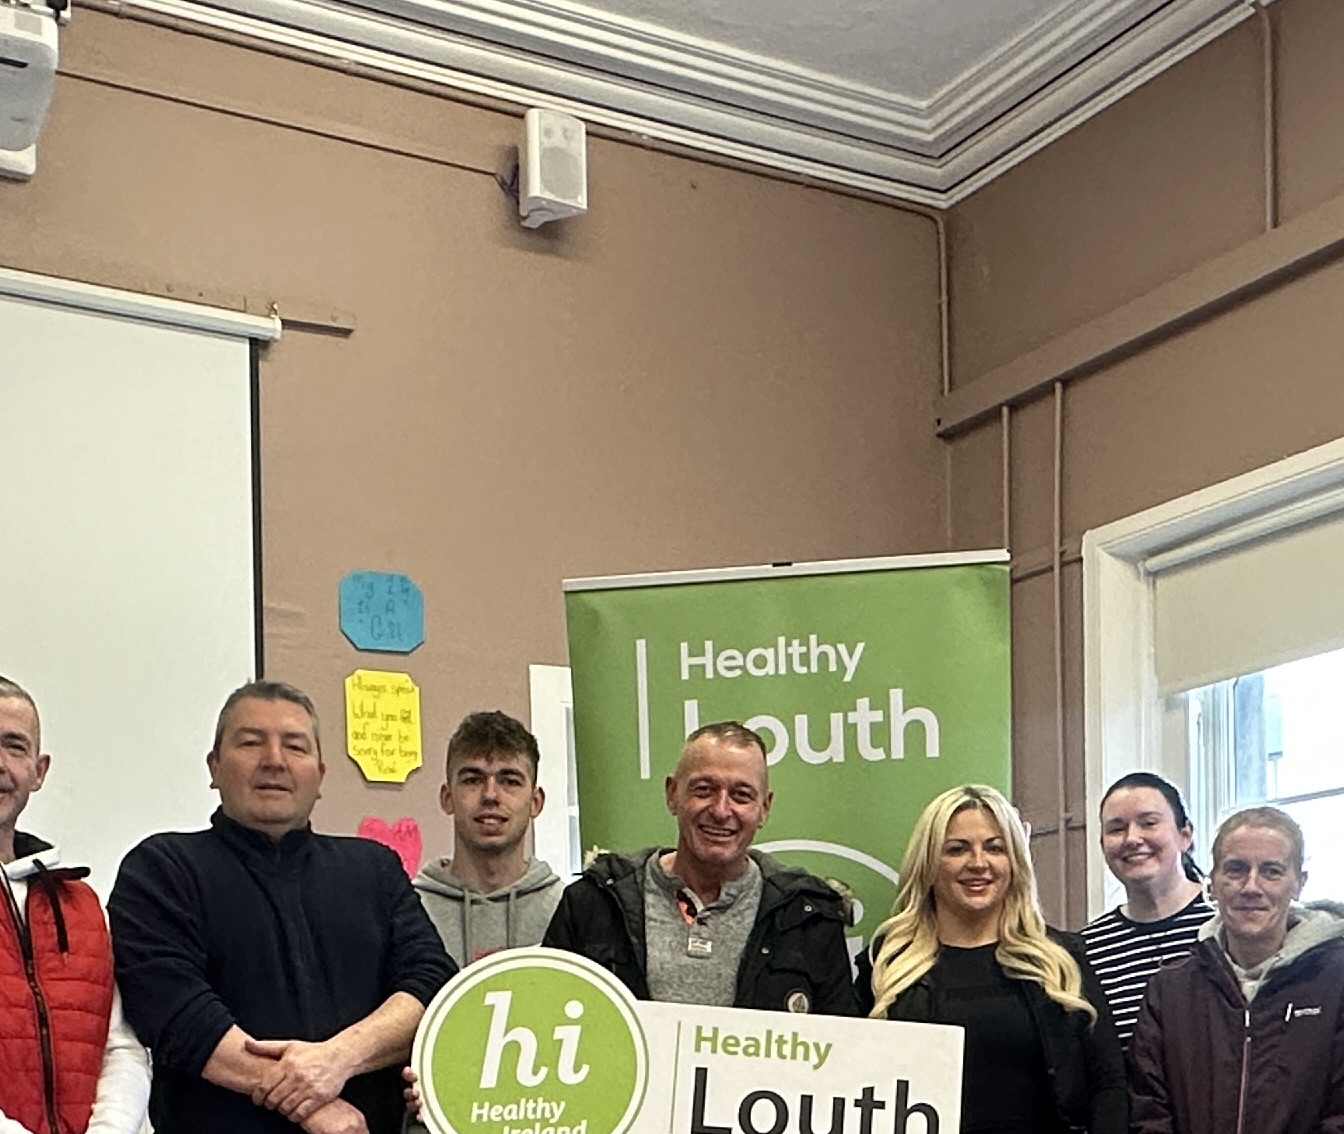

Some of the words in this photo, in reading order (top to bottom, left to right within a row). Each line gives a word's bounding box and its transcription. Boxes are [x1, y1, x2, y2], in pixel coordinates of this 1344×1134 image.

[679, 634, 866, 682] Healthy
[479, 989, 590, 1089] hi
[693, 1024, 834, 1071] Healthy
[470, 1097, 566, 1125] Healthy
